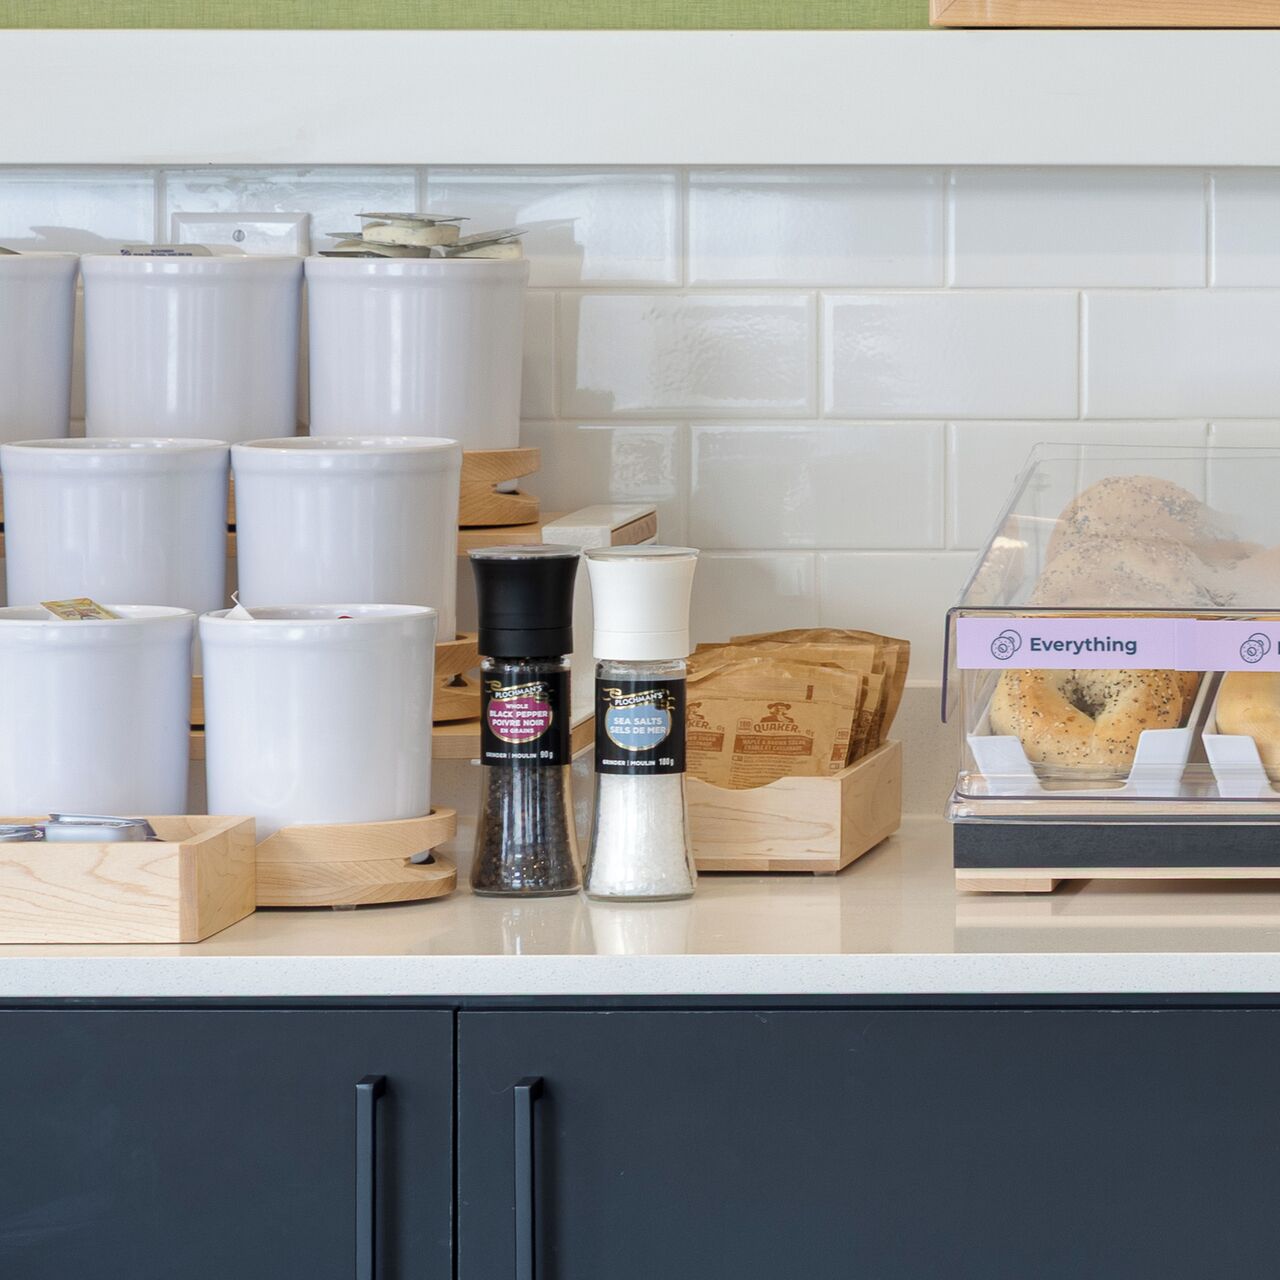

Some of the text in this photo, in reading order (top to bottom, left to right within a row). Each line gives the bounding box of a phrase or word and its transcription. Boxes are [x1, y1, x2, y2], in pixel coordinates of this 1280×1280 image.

[1029, 636, 1138, 655] Everything
[614, 692, 664, 705] PLOCHMAN'S
[492, 719, 521, 727] POIVRE
[613, 717, 663, 726] SEA SALTS
[609, 726, 666, 734] SELS DE MER
[753, 723, 799, 733] QUAKER
